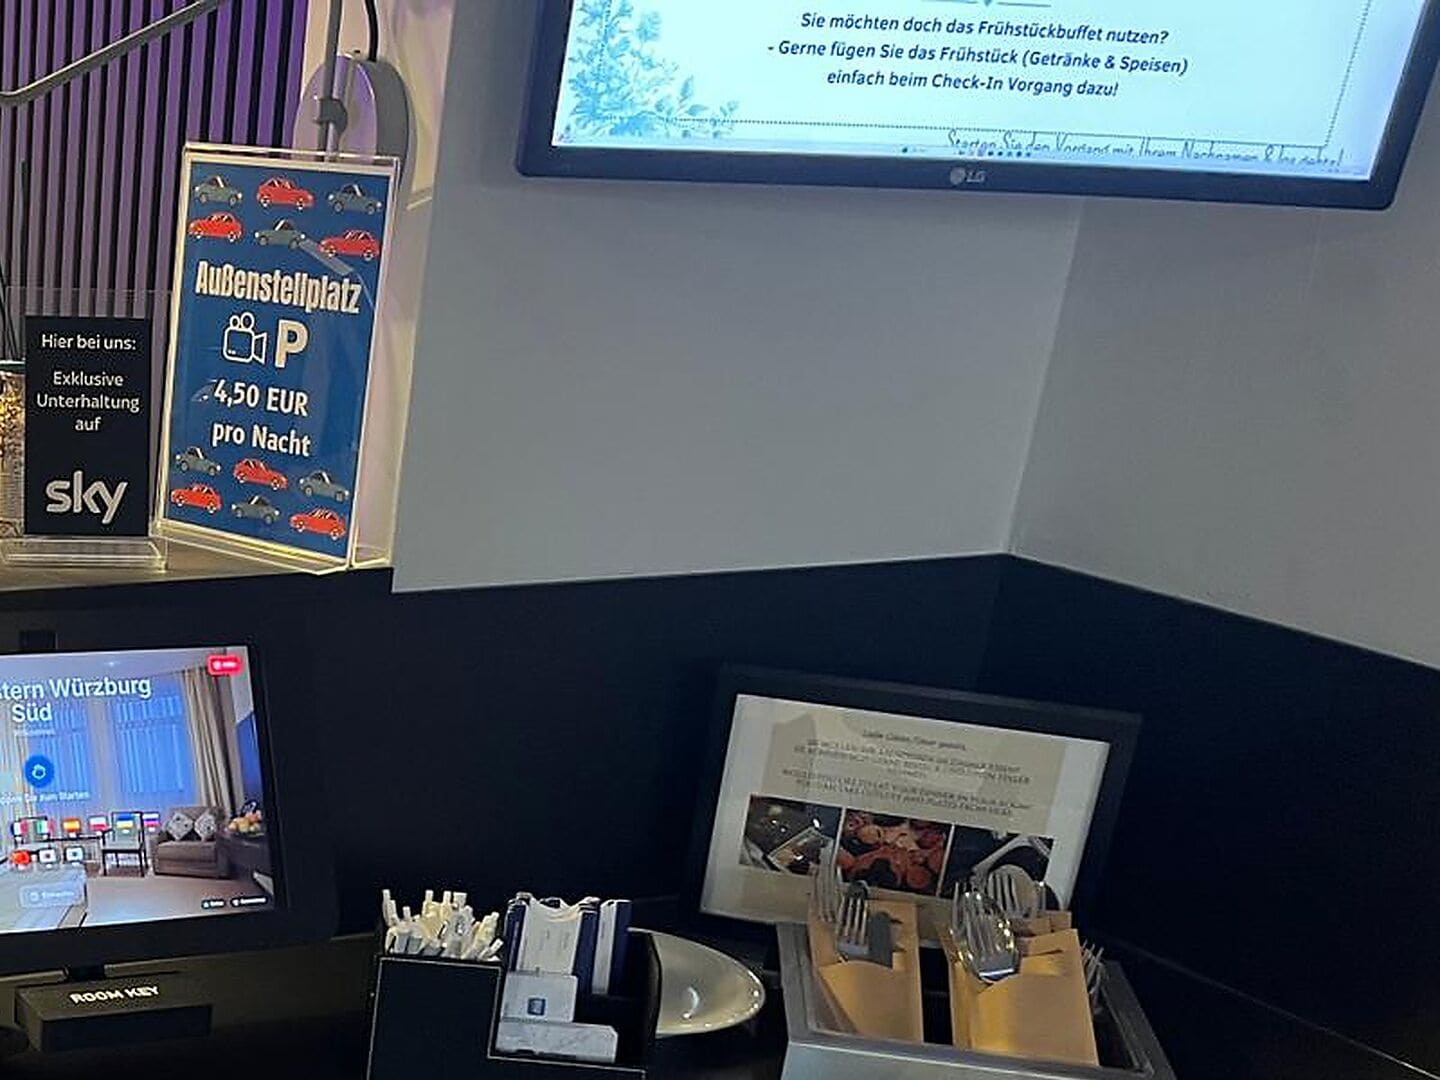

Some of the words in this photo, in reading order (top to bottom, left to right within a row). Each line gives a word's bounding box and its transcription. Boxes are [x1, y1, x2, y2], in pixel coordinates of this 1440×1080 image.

[801, 13, 825, 28] Sie
[829, 14, 899, 31] möchten
[903, 17, 942, 32] doch
[946, 19, 974, 34] das
[978, 21, 1102, 42] Frühstückbuffet
[1106, 29, 1170, 44] nutzen?
[778, 40, 826, 56] Gerne
[830, 41, 875, 60] fügen
[880, 44, 908, 59] Sie
[908, 45, 935, 60] das
[939, 46, 1018, 64] Frühstück
[1022, 50, 1101, 69] (Getränke
[1104, 55, 1115, 68] &
[1119, 56, 1188, 77] Speisen)
[827, 69, 885, 86] einfach
[889, 72, 927, 87] beim
[932, 73, 1003, 90] Check-In
[1008, 78, 1073, 97] Vorgang
[1077, 80, 1119, 97] dazu!
[966, 170, 987, 183] LG
[195, 260, 362, 314] Außenstellplatz
[41, 334, 73, 348] Hier
[77, 335, 100, 349] bei
[104, 337, 137, 350] uns:
[275, 319, 309, 368] P
[53, 371, 124, 386] Exklusive
[36, 393, 140, 413] Unterhaltung
[214, 379, 259, 408] 4,50
[267, 388, 309, 417] EUR
[75, 417, 101, 431] auf
[212, 423, 245, 447] pro
[252, 425, 311, 457] Nacht
[46, 471, 128, 524] sky
[49, 677, 152, 700] Würzburg
[12, 702, 53, 723] Süd
[70, 989, 124, 1004] ROOM
[124, 986, 159, 998] KEY
